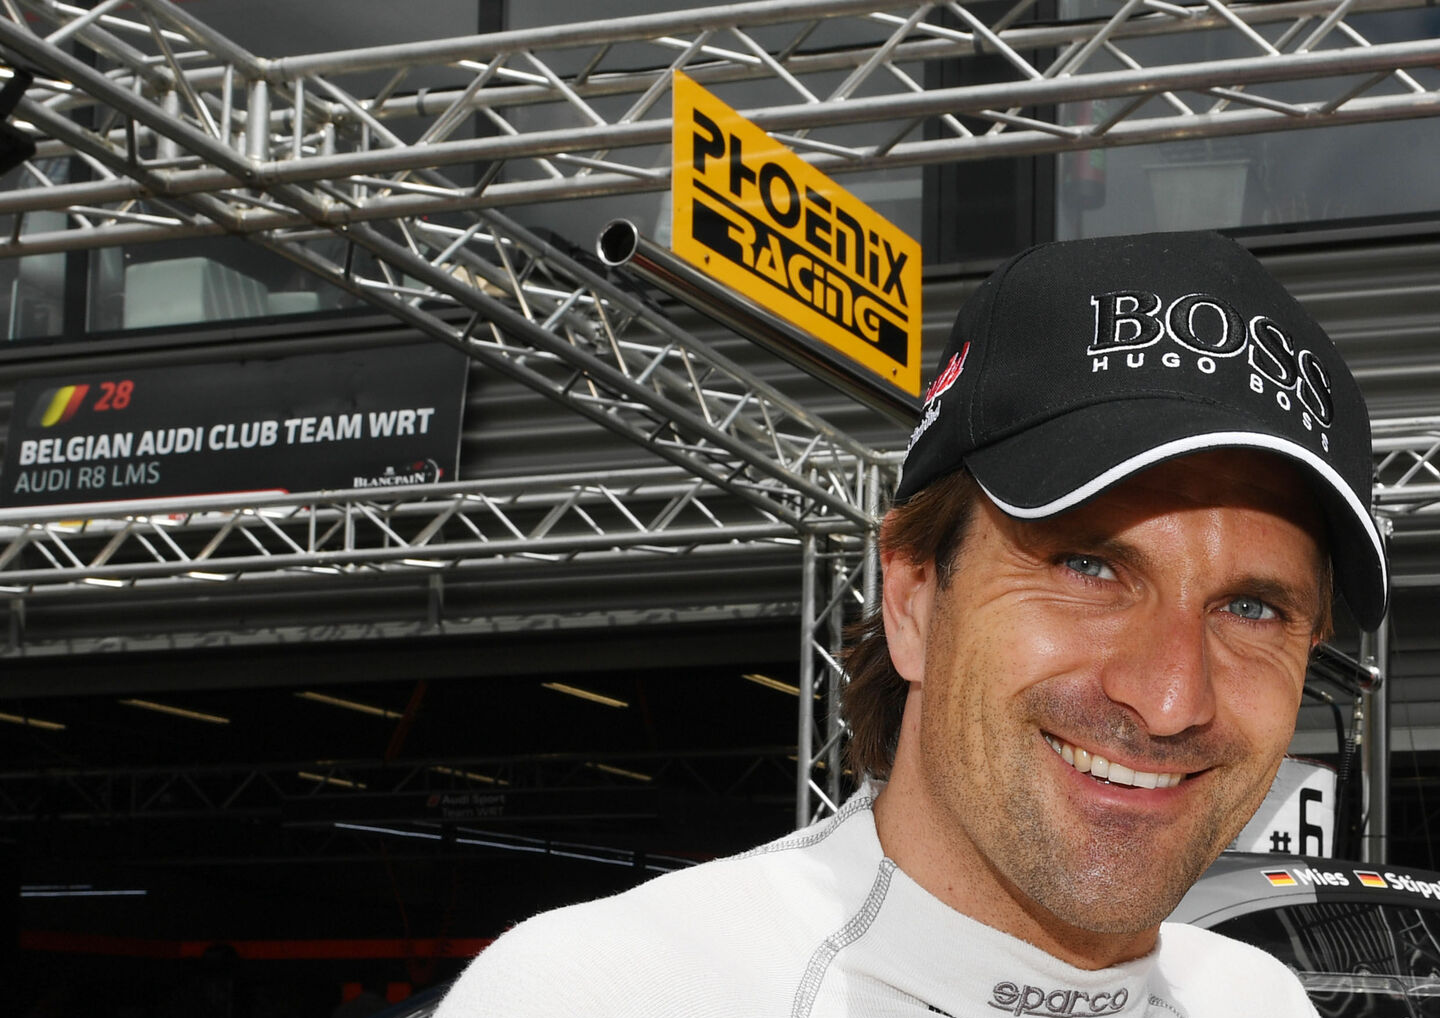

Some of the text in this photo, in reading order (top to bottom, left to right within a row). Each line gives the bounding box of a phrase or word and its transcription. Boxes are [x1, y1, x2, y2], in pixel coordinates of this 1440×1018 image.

[1086, 289, 1334, 428] BOSS
[93, 380, 135, 411] 28
[1092, 351, 1331, 454] HUGO BOSS
[19, 407, 436, 466] BELGIAN AUDI CLUB TEAM WRT
[14, 461, 161, 494] AUDI R8 LMS
[1293, 867, 1350, 888] Mies
[990, 980, 1130, 1018] sparco
